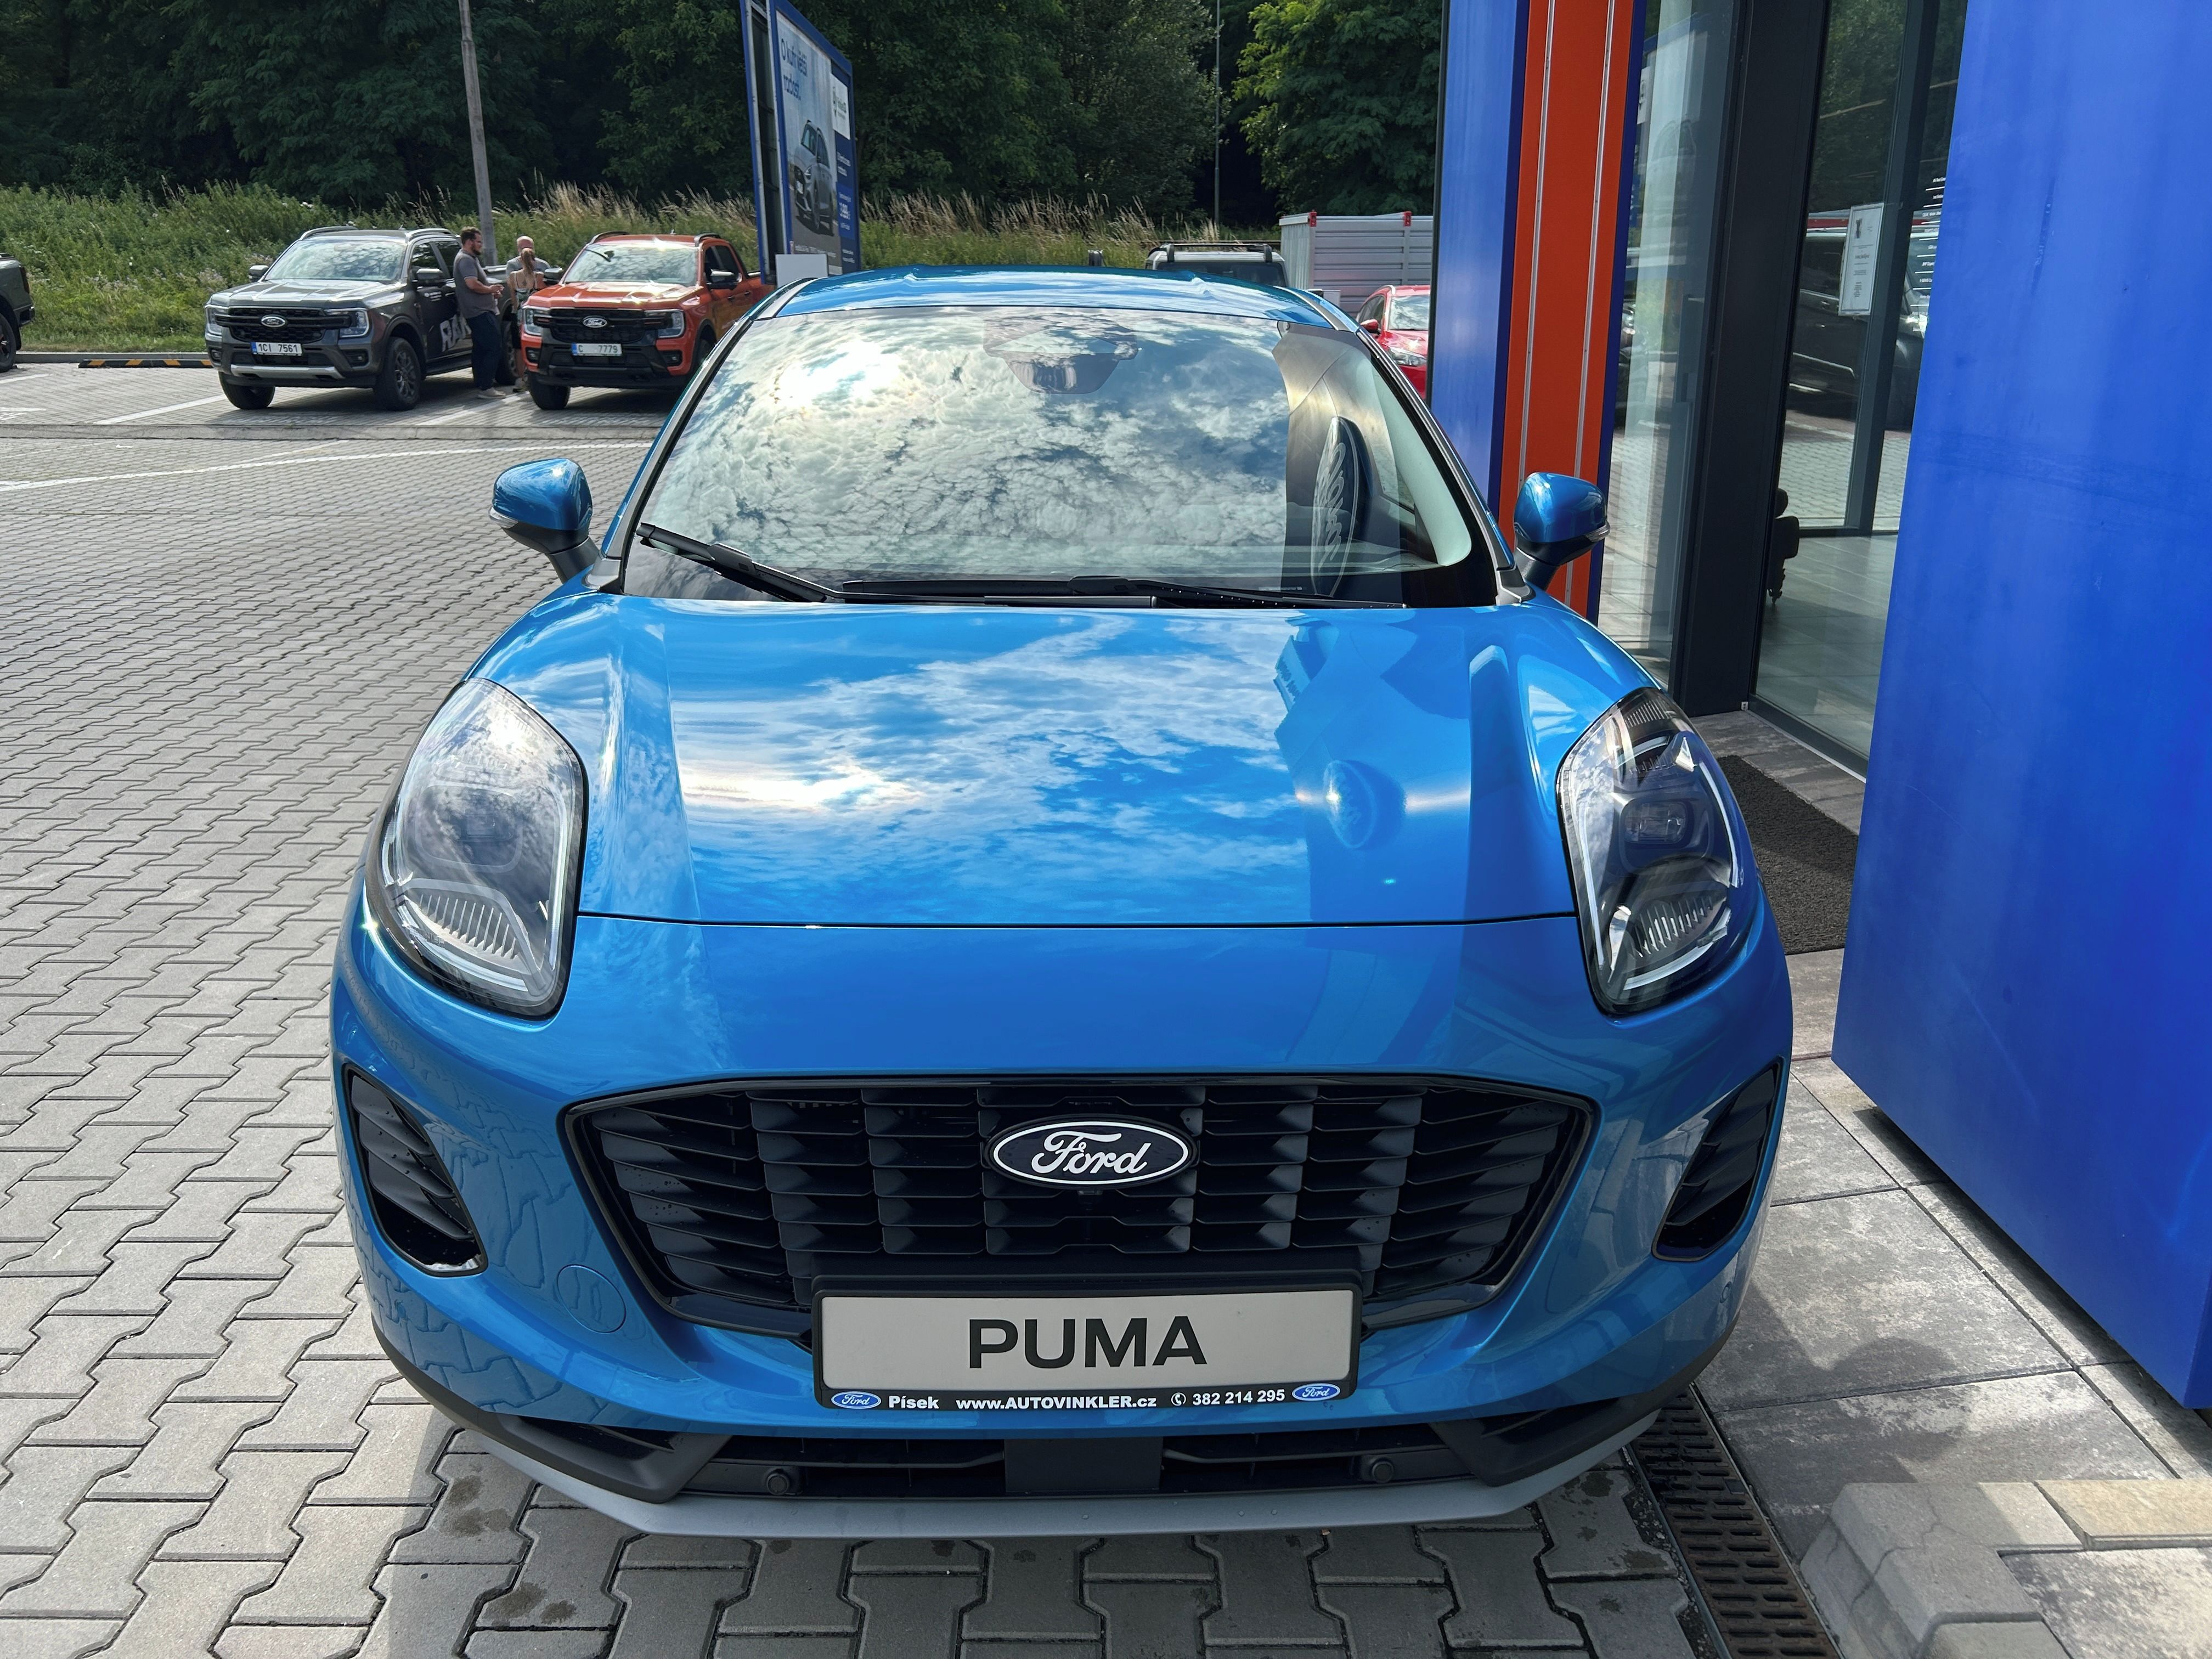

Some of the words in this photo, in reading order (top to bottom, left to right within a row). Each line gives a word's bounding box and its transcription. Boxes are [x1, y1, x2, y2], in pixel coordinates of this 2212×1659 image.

[278, 344, 298, 353] 7561
[1031, 1130, 1152, 1175] Ford
[969, 1316, 1207, 1369] PUMA
[840, 1394, 871, 1406] Ford
[888, 1395, 940, 1409] Písek
[955, 1395, 1158, 1410] www.AUTOVINKLER.cz
[1192, 1392, 1221, 1406] 382
[1224, 1390, 1254, 1405] 214
[1257, 1389, 1285, 1403] 295
[1301, 1385, 1330, 1398] Ford
